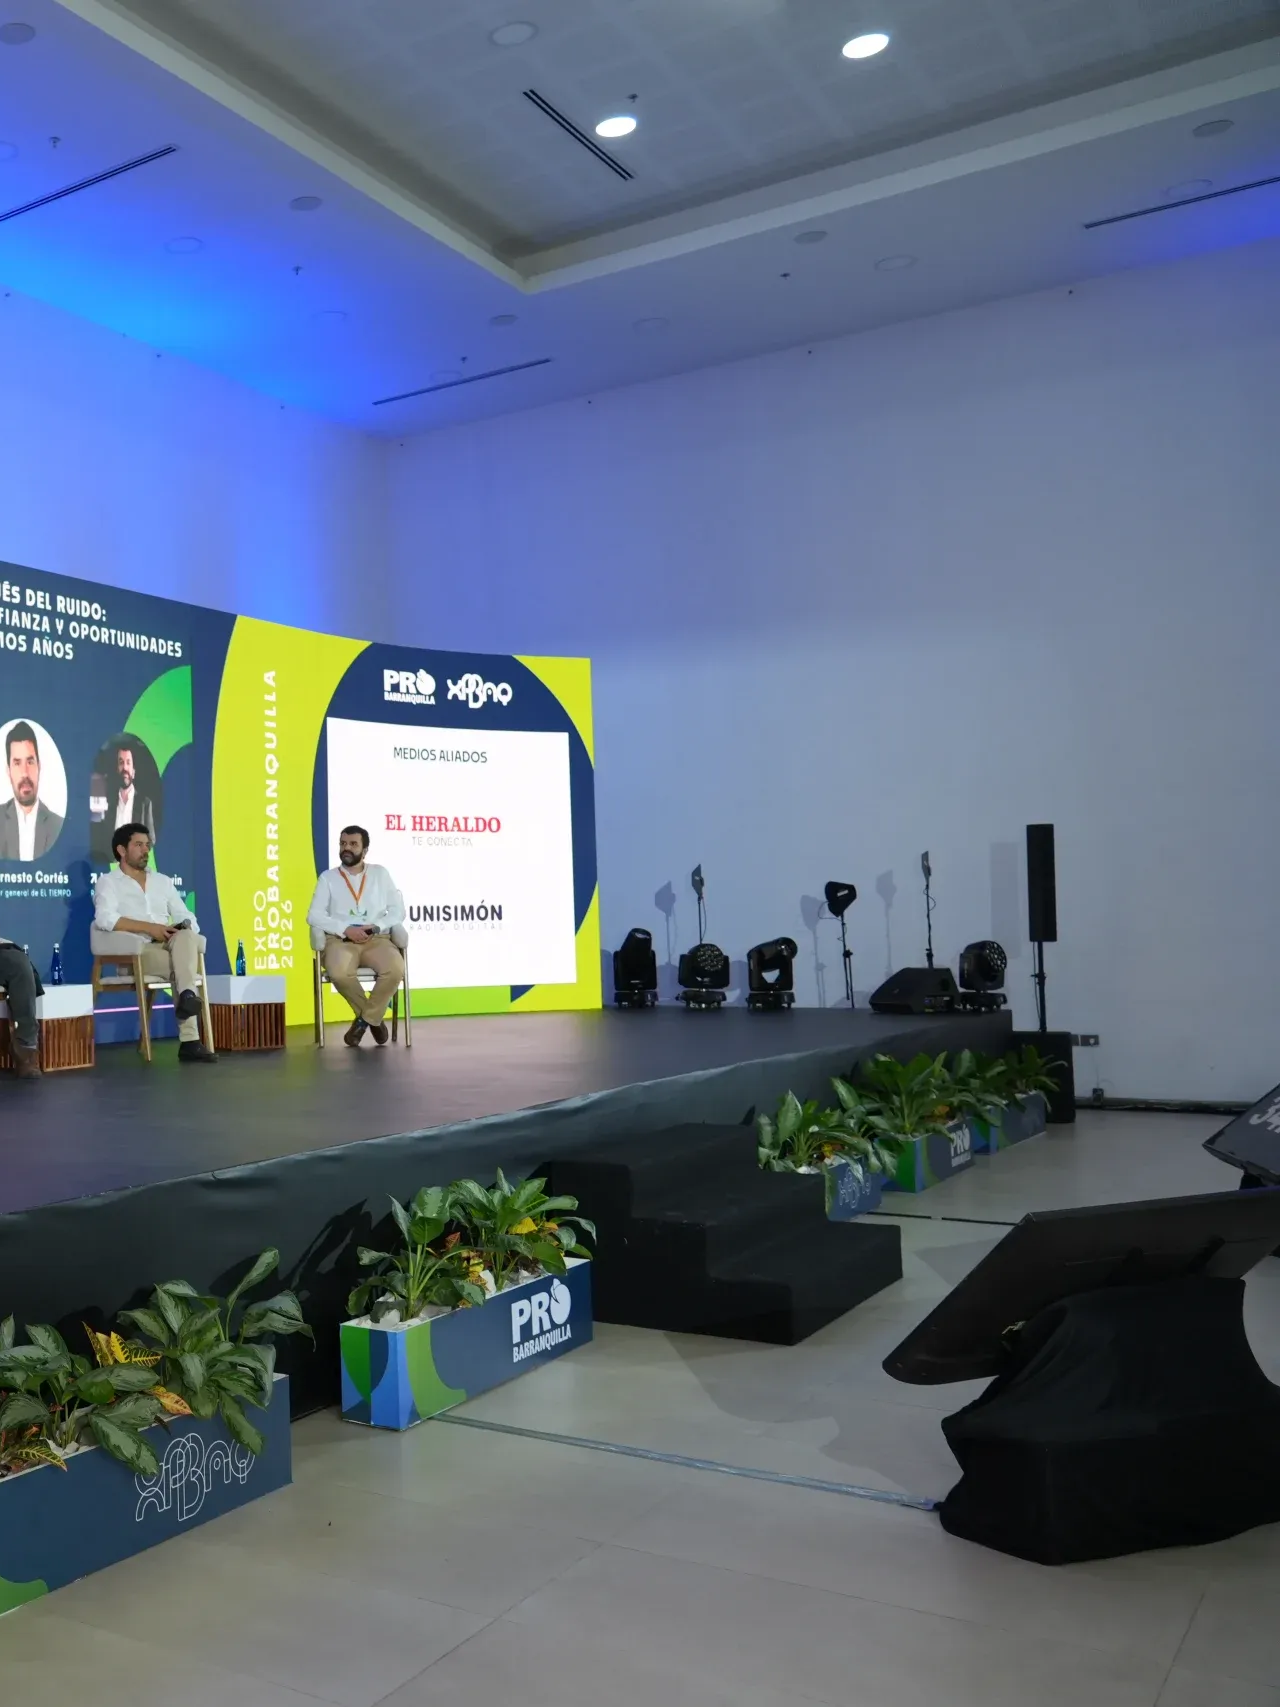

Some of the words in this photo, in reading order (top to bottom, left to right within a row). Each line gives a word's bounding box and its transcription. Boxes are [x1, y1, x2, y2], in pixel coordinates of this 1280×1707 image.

[25, 588, 52, 610] DEL
[56, 595, 107, 622] RUIDO:
[32, 635, 74, 660] AÑOS
[55, 618, 64, 635] Y
[69, 621, 183, 658] OPORTUNIDADES
[383, 668, 436, 696] PRO
[393, 746, 437, 761] MEDIOS
[439, 749, 488, 763] ALIADOS
[263, 670, 280, 970] PROBARRANQUILLA
[384, 814, 406, 831] EL
[411, 815, 501, 833] HERALDO
[412, 836, 423, 846] TE
[426, 836, 473, 847] CONECTA
[35, 870, 69, 884] Cortés
[5, 889, 30, 899] general
[31, 888, 39, 897] de
[40, 888, 47, 897] EL
[48, 888, 72, 898] TIEMPO
[409, 899, 503, 922] UNISIMÓN
[253, 890, 267, 970] EXPO
[280, 899, 293, 969] 2026
[511, 1277, 572, 1345] PRO
[512, 1323, 572, 1363] BARRANQUILLA
